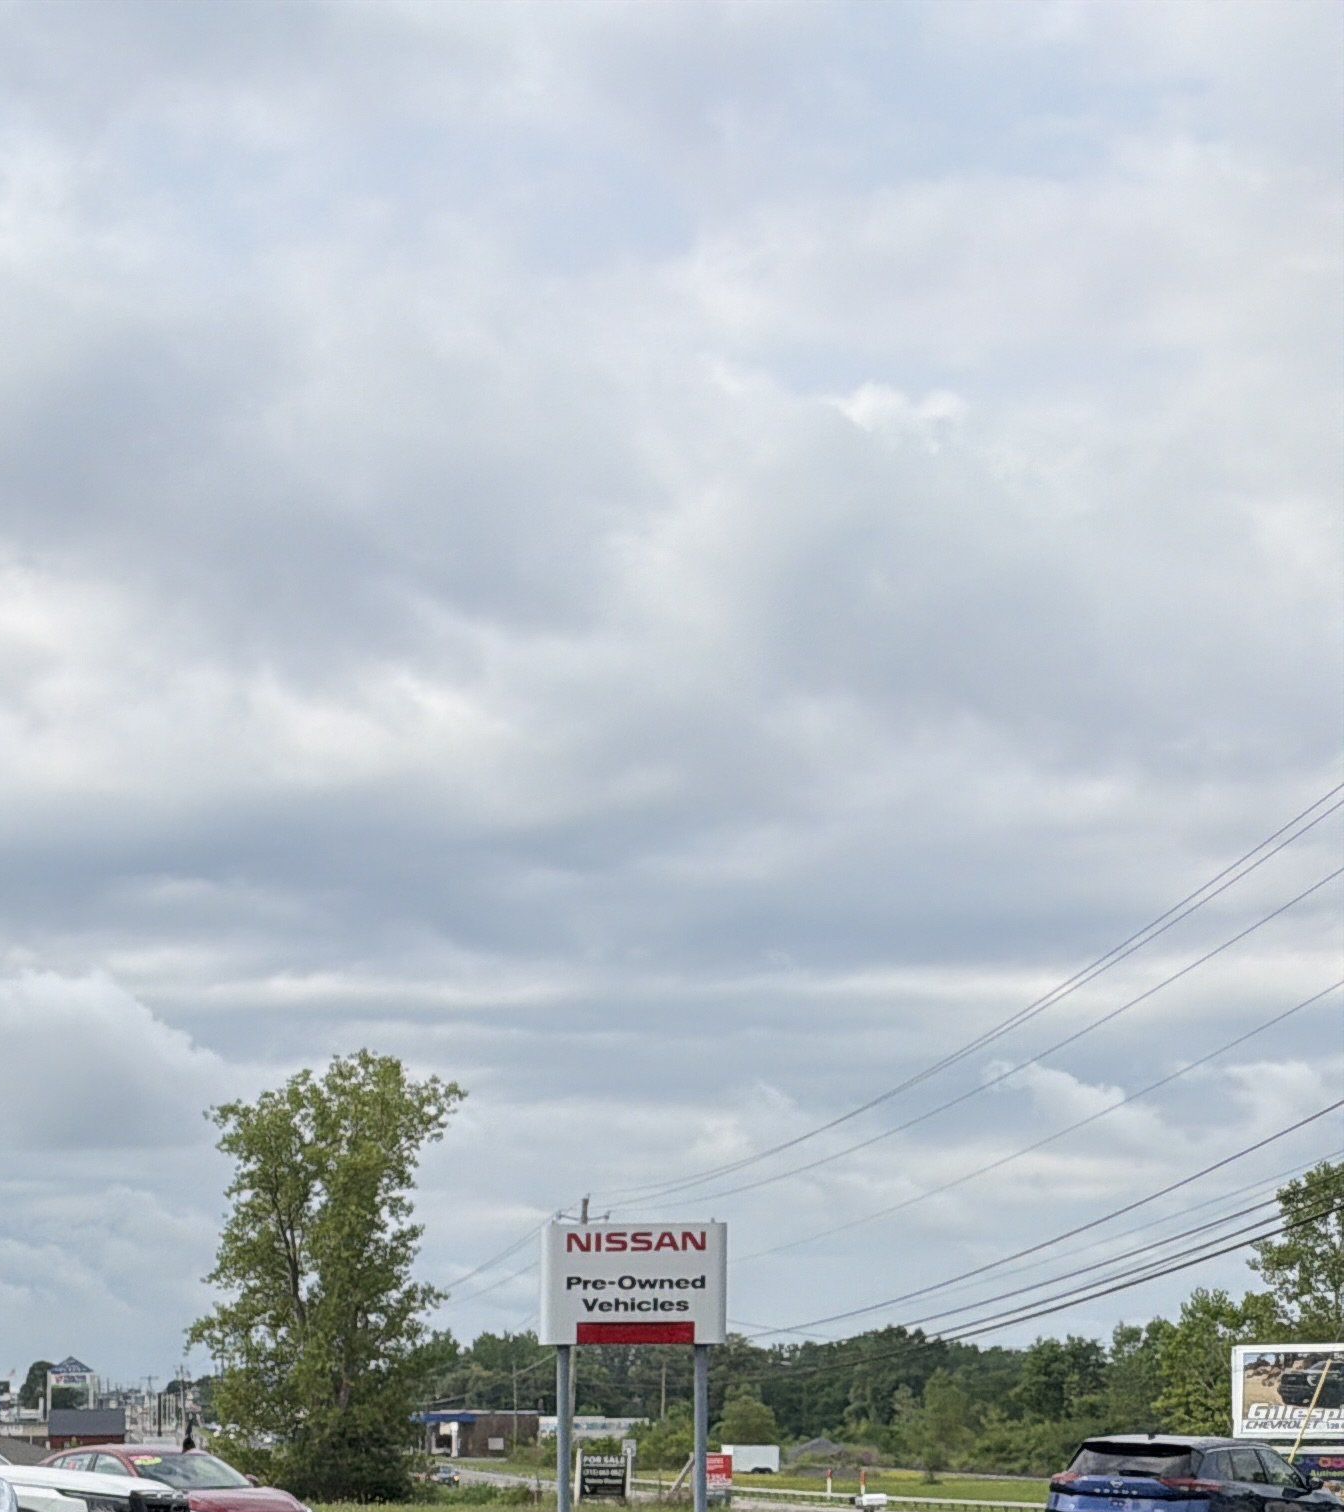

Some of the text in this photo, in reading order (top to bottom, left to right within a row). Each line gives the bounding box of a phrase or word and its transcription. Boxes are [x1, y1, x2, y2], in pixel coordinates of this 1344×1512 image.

[566, 1231, 707, 1253] NISSAN
[566, 1274, 707, 1291] Pre-Owned
[582, 1297, 690, 1313] Vehicles
